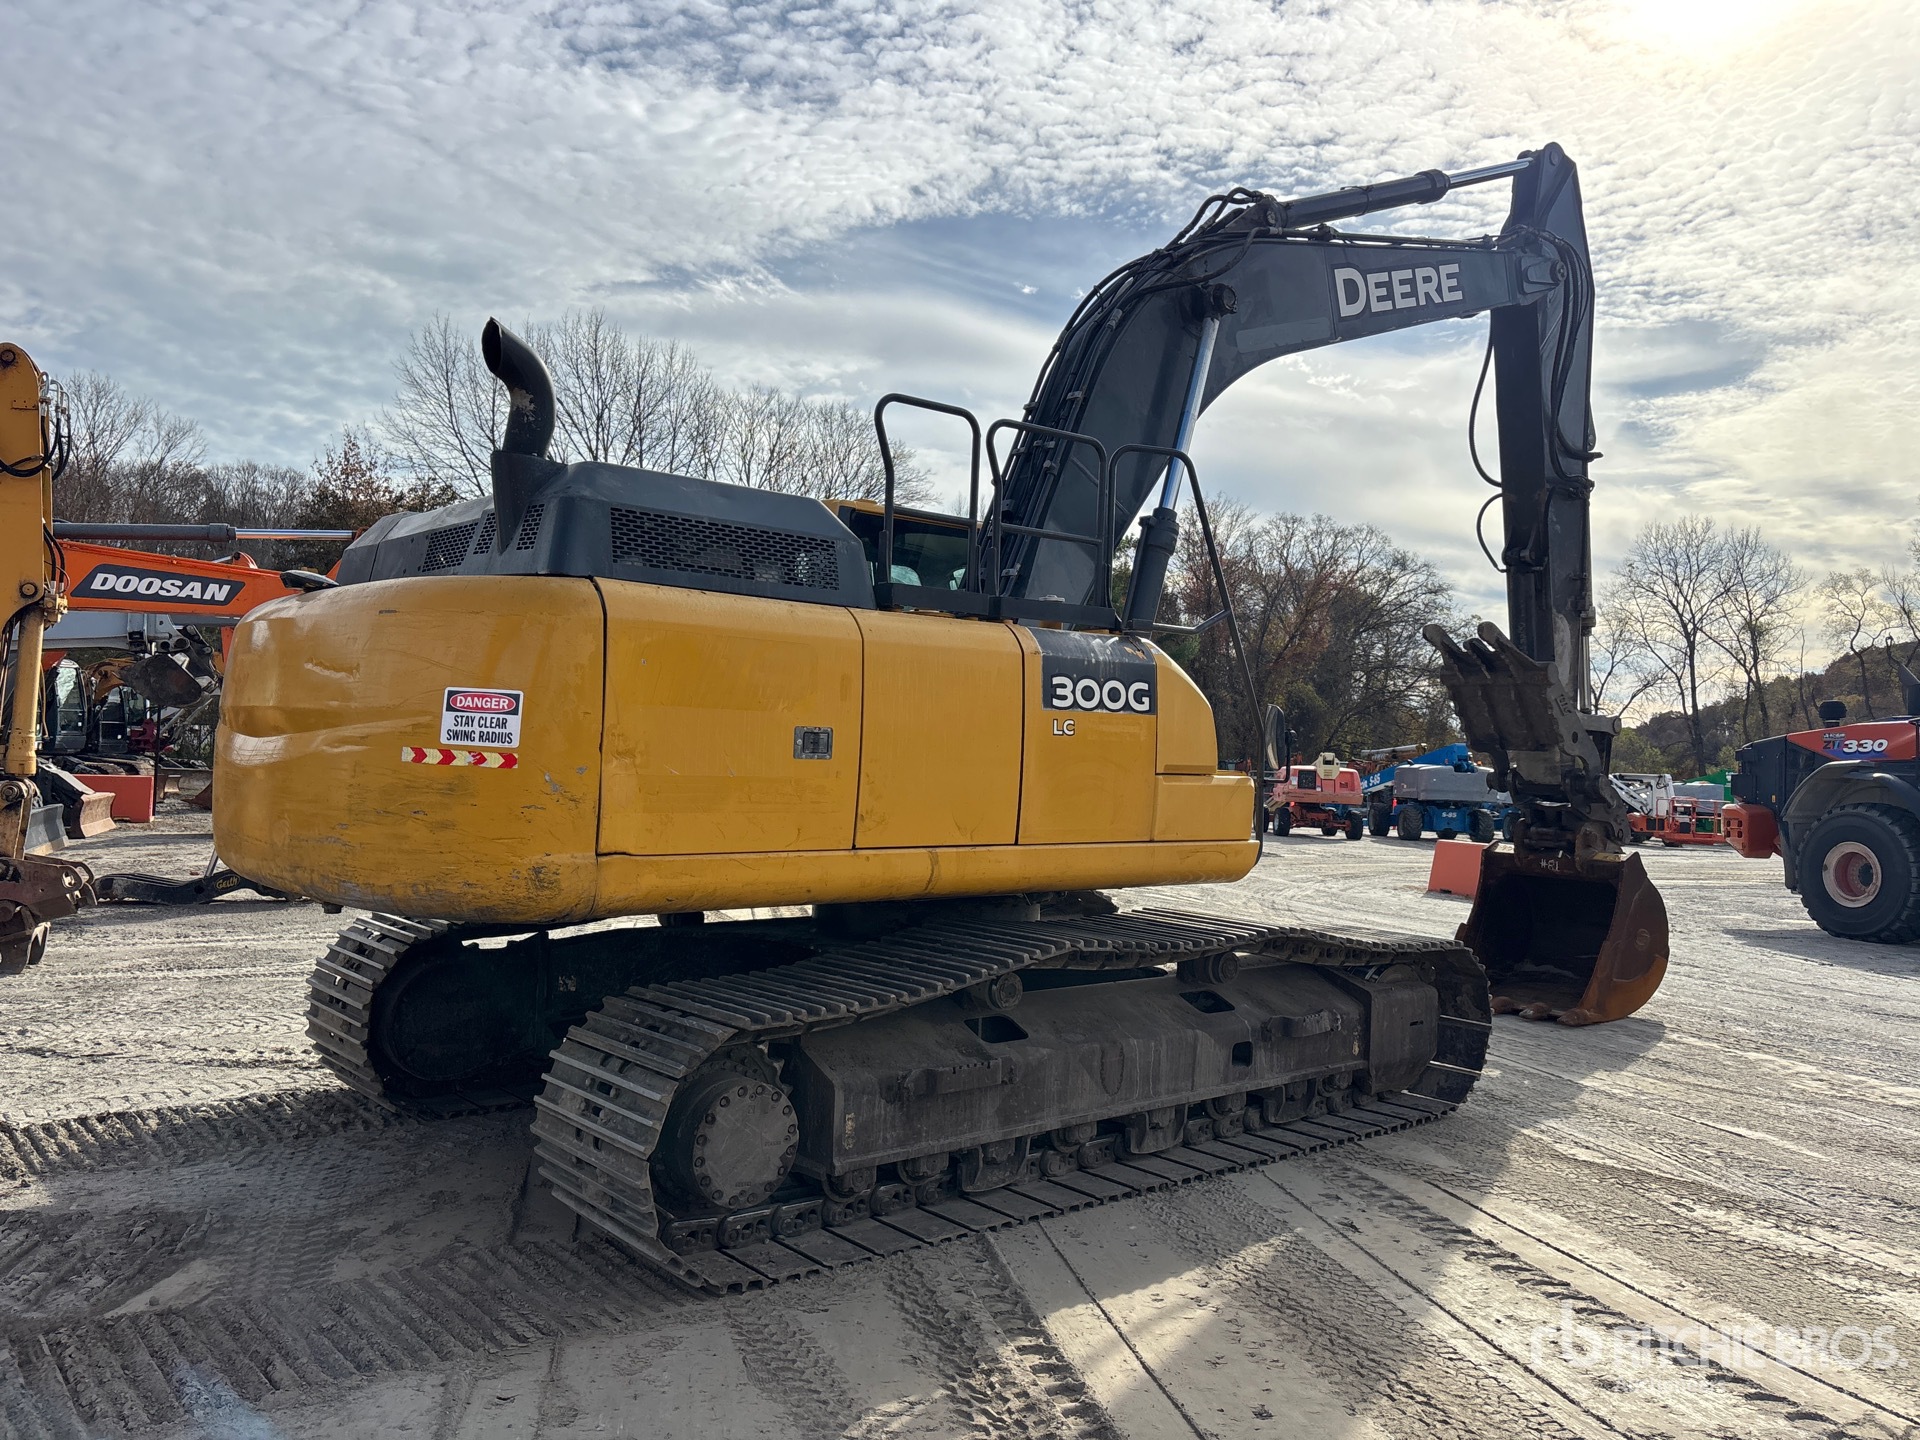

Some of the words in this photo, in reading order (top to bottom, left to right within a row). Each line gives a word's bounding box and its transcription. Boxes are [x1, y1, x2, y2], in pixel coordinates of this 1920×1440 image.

[1334, 263, 1463, 317] DEERE
[90, 573, 231, 602] DOOSAN
[1051, 675, 1151, 712] 300G
[456, 696, 509, 710] DANGER
[453, 714, 476, 728] STAY
[477, 715, 508, 730] CLEAR
[1053, 719, 1075, 735] LC
[446, 728, 476, 742] SWING
[478, 730, 513, 744] RADIUS
